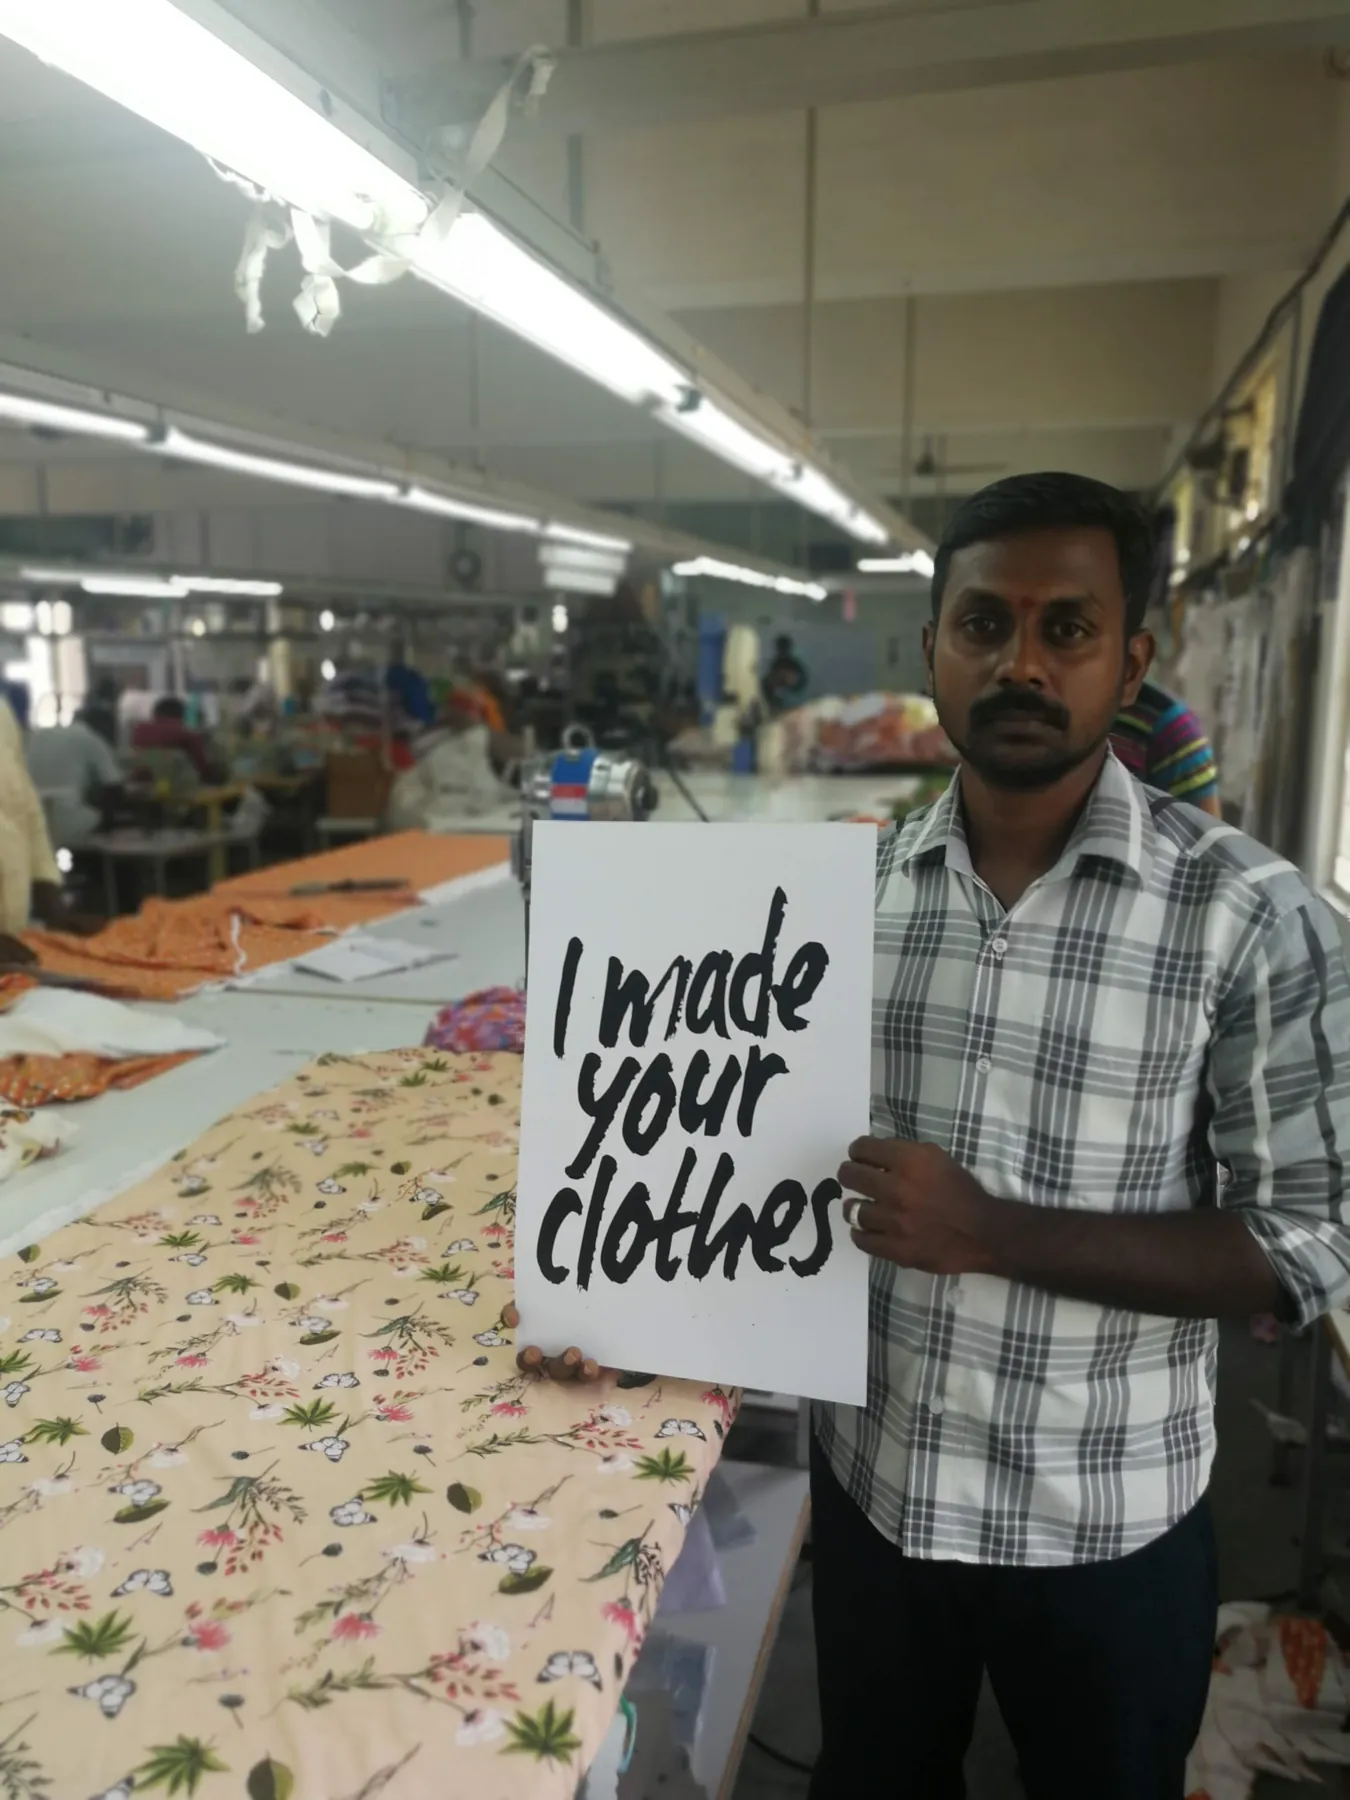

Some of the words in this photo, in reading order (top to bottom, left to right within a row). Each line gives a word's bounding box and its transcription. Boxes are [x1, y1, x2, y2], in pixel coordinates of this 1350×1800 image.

[553, 936, 583, 1059] I
[598, 886, 830, 1049] made
[564, 1044, 790, 1180] your
[536, 1146, 843, 1292] clothes
